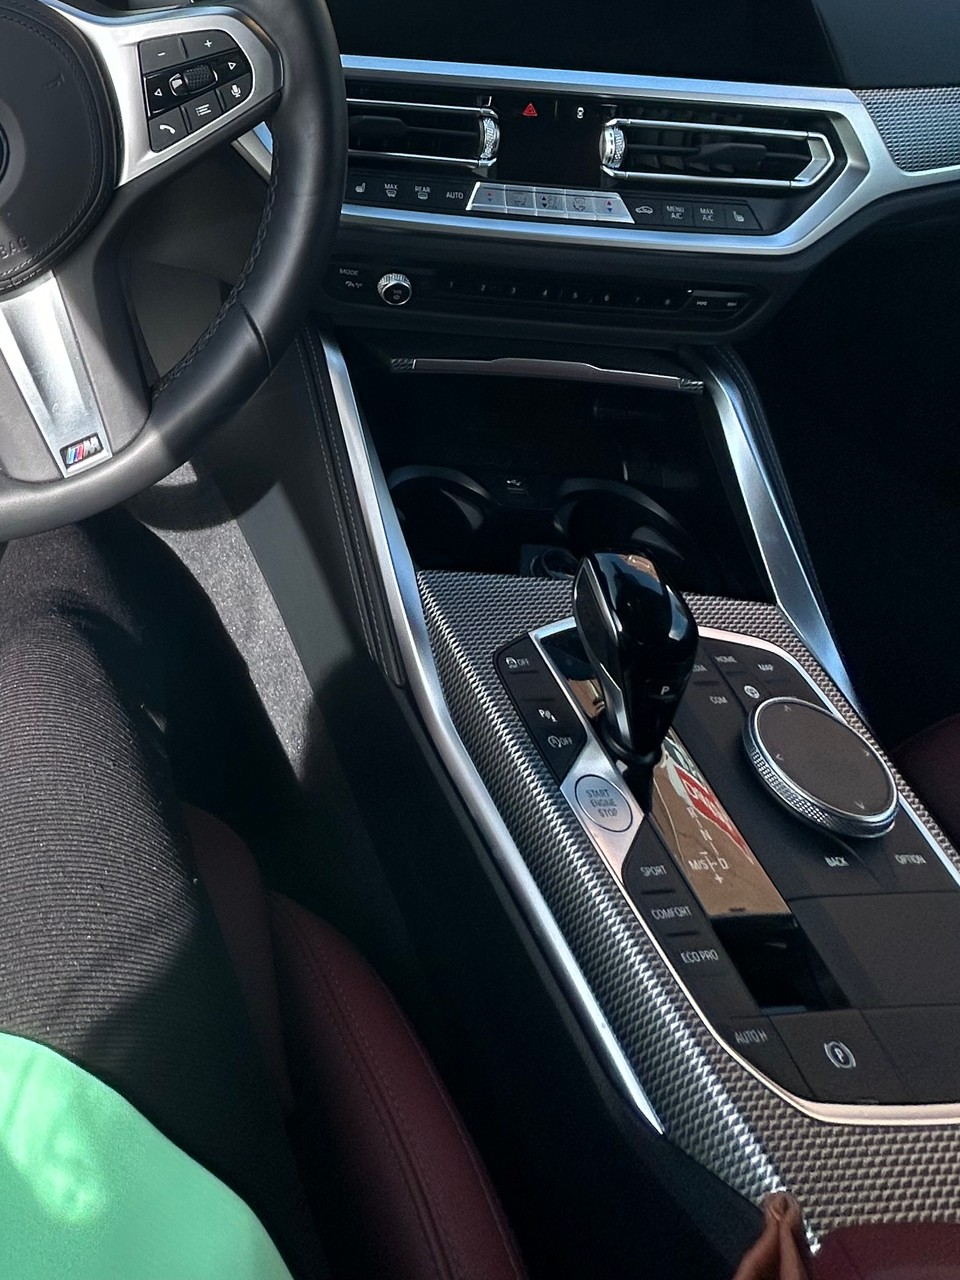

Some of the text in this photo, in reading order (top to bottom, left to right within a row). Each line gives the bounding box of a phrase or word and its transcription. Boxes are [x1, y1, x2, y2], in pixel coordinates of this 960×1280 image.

[384, 182, 398, 190] MAX
[414, 185, 431, 193] REAR
[445, 191, 464, 199] AUTO
[666, 205, 685, 213] MENU
[699, 207, 714, 215] MAX
[660, 685, 670, 696] P
[559, 736, 573, 746] OFF
[585, 788, 610, 798] START
[590, 799, 617, 807] ENGINE
[598, 808, 618, 818] STOP
[700, 829, 712, 841] N
[718, 857, 730, 870] D
[824, 856, 850, 868] BACK
[894, 854, 928, 865] OPTION
[688, 860, 709, 870] M/S
[640, 864, 667, 877] SPORT
[651, 906, 692, 920] COMFORT
[680, 949, 719, 964] ECO PRO
[734, 1029, 760, 1044] AUTO
